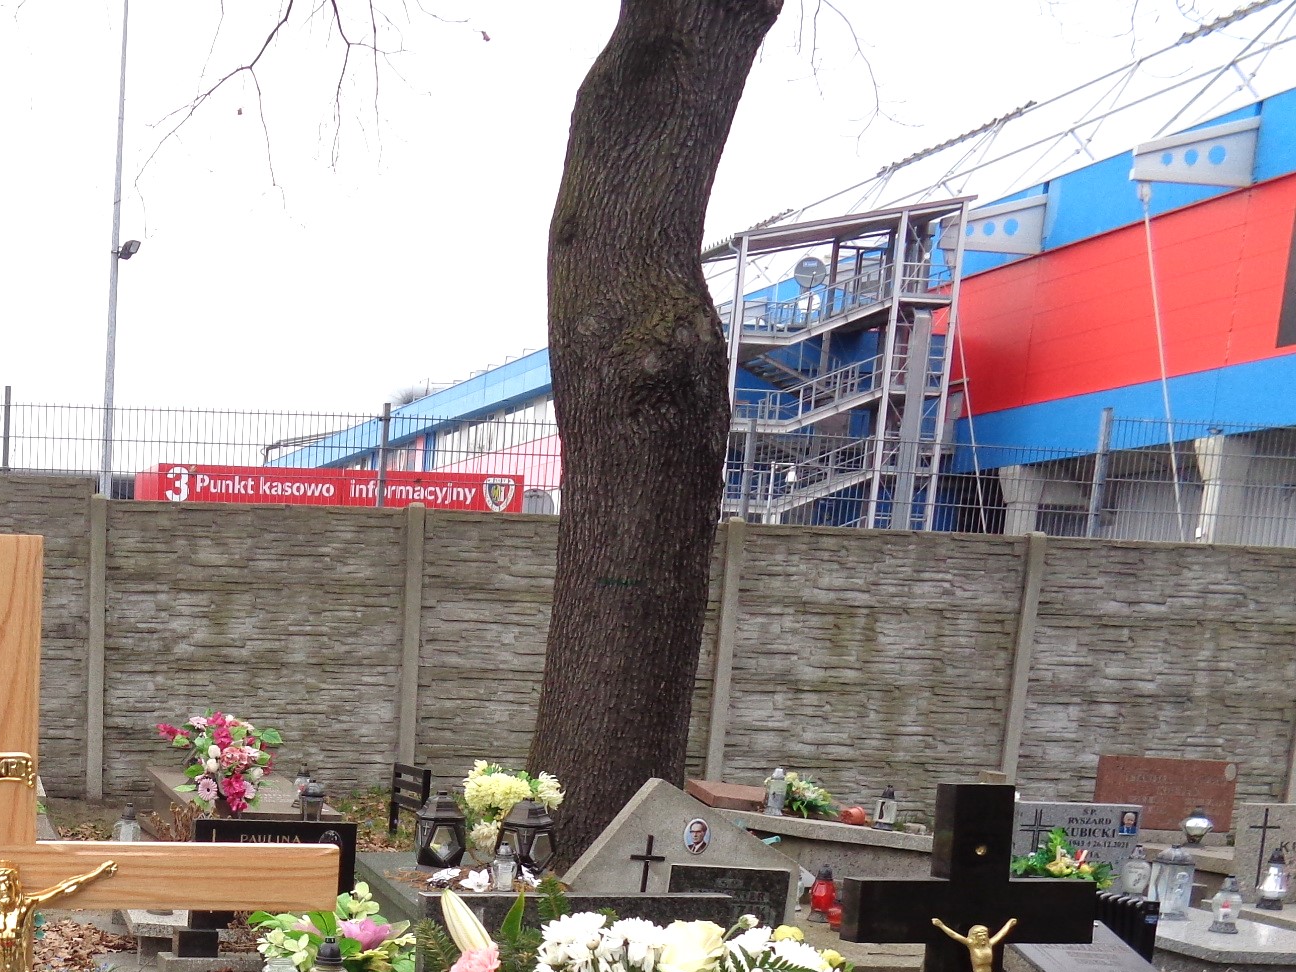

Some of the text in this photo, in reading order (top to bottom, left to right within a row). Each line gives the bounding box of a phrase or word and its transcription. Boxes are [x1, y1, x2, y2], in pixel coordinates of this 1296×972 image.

[165, 467, 190, 502] 3
[195, 474, 255, 495] Punkt
[259, 477, 335, 497] kasowo
[349, 479, 476, 504] informacyjny
[1068, 817, 1112, 825] RYSZARD
[1062, 827, 1116, 838] KUBICKI
[240, 834, 301, 843] PAULINA
